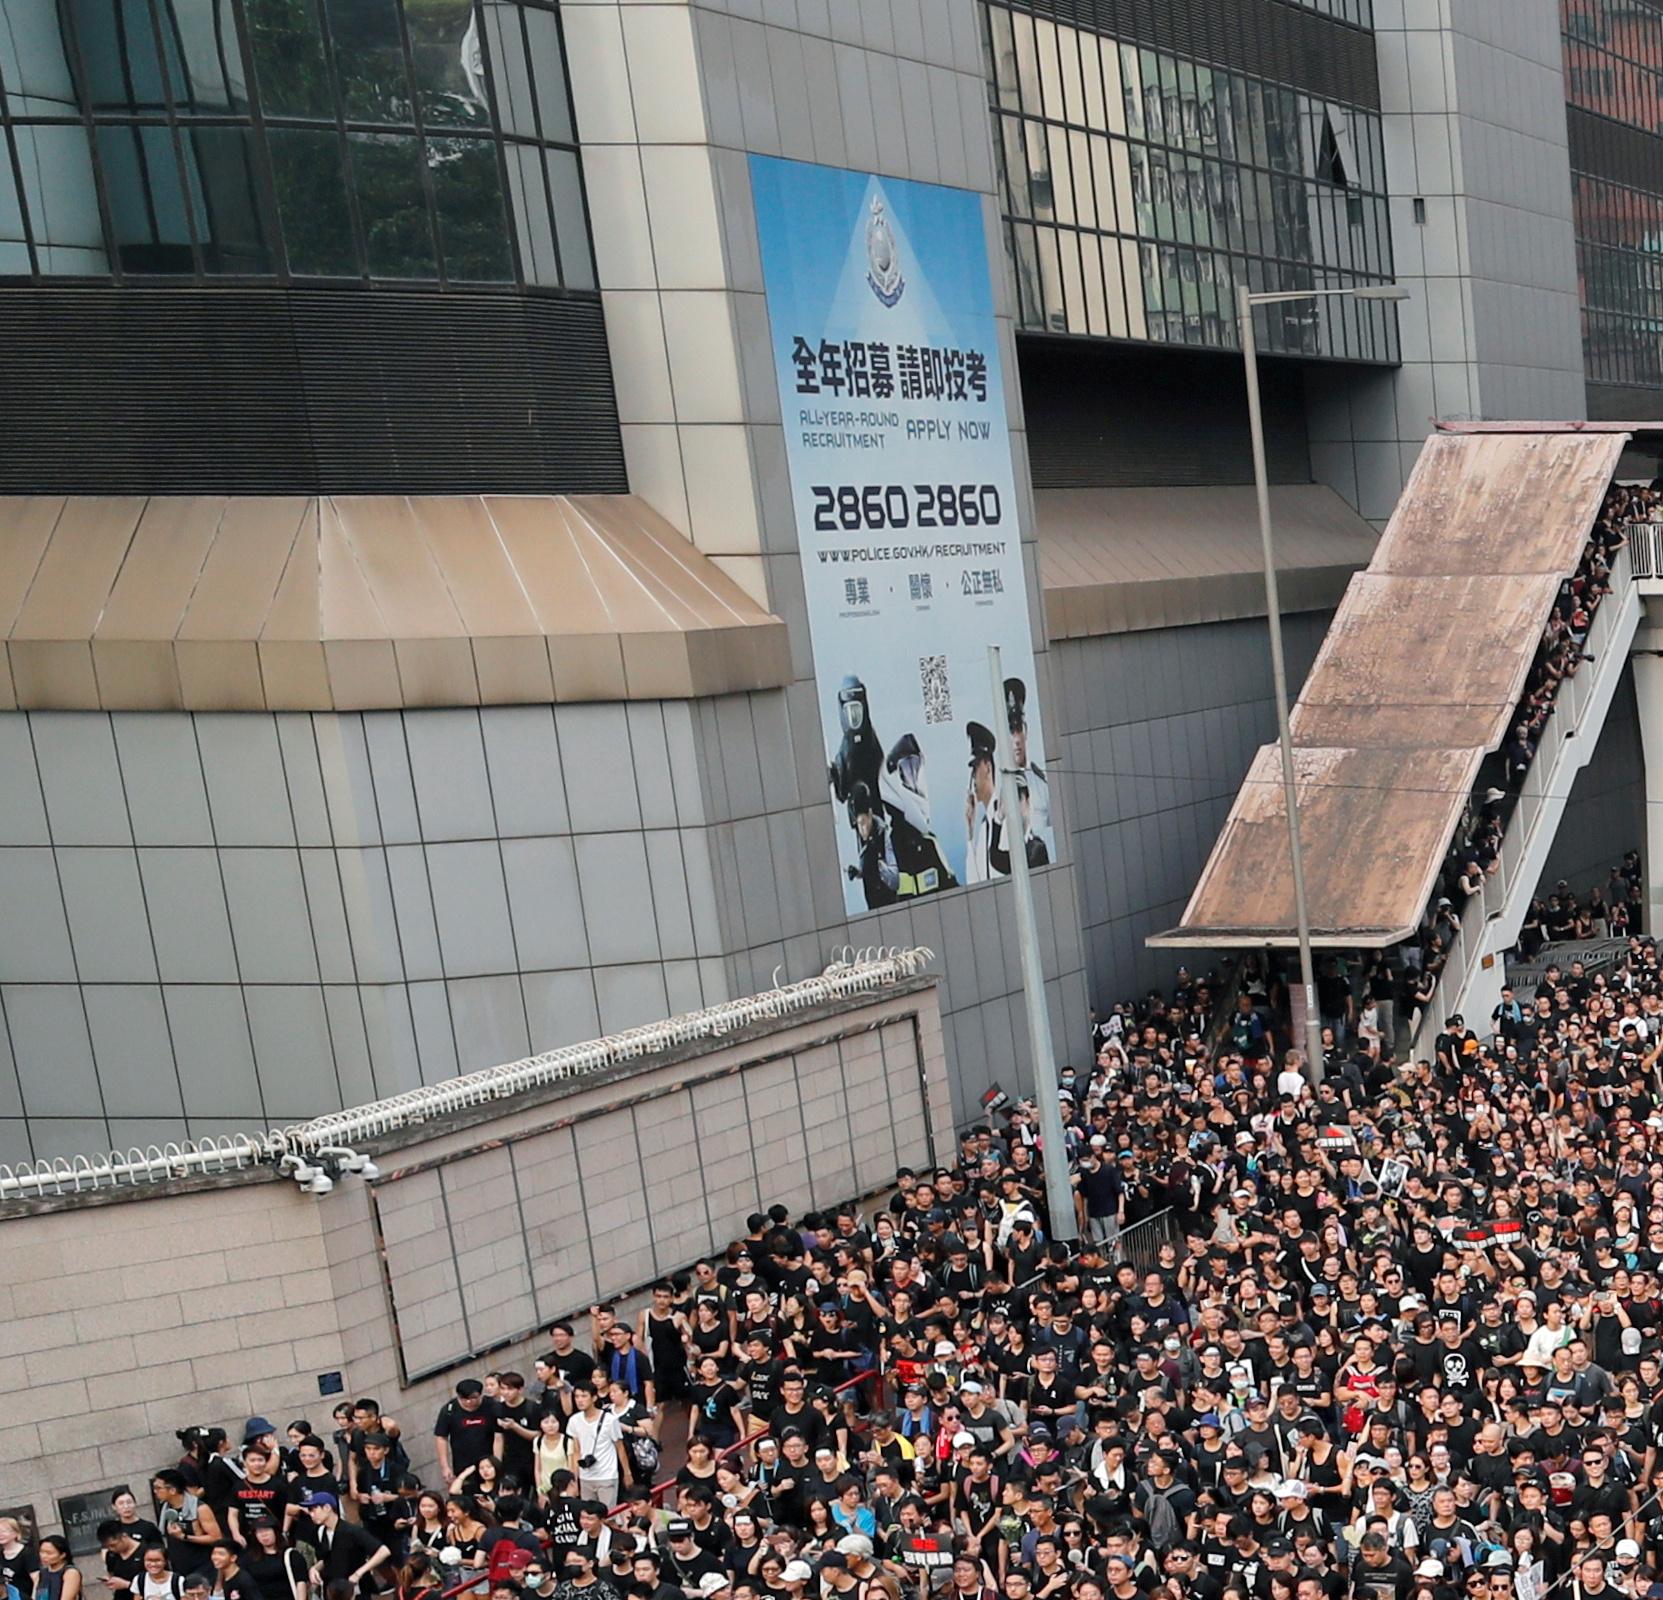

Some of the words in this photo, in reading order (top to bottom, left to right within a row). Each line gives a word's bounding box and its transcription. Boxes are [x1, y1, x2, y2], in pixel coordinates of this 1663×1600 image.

[791, 336, 895, 400] 全年招募
[896, 344, 987, 403] 請即投考
[799, 409, 899, 428] ALL-YEAR-ROUND
[906, 417, 952, 442] APPLY
[958, 421, 991, 442] NOW
[802, 432, 886, 450] RECRUITMENT
[811, 485, 909, 531] 2860
[914, 484, 1001, 527] 2860
[817, 541, 1006, 564] WWW.POLICE.GOV.HK/RECRUITMENT
[844, 577, 871, 605] 專業
[960, 568, 1005, 596] 公正無私
[237, 1490, 274, 1499] RESTART
